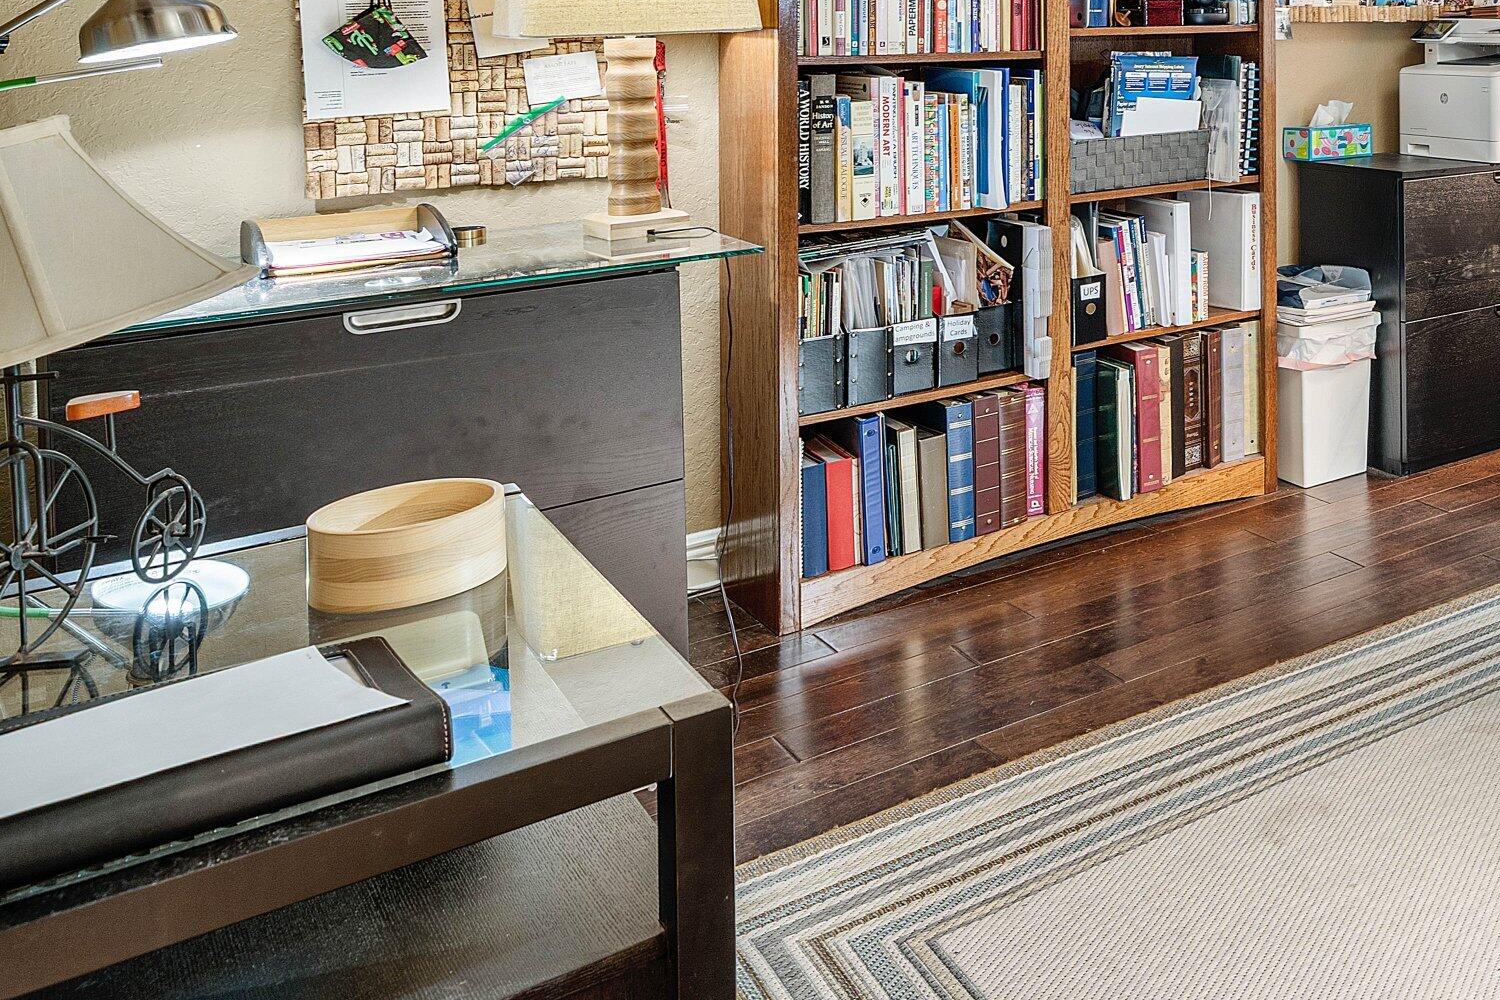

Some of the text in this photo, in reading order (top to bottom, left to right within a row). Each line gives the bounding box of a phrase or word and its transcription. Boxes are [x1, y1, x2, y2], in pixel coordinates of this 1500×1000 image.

[812, 111, 835, 122] History
[812, 121, 834, 130] of Art
[882, 95, 891, 157] MODERN ART
[799, 88, 809, 190] A WORLD HISTORY
[840, 131, 848, 200] VISUAL DIALOGUE
[911, 131, 919, 190] ART TECHNIQUES
[1083, 285, 1099, 297] UPS
[894, 322, 924, 334] Camping
[947, 319, 971, 328] Holiday
[949, 328, 968, 337] Cards
